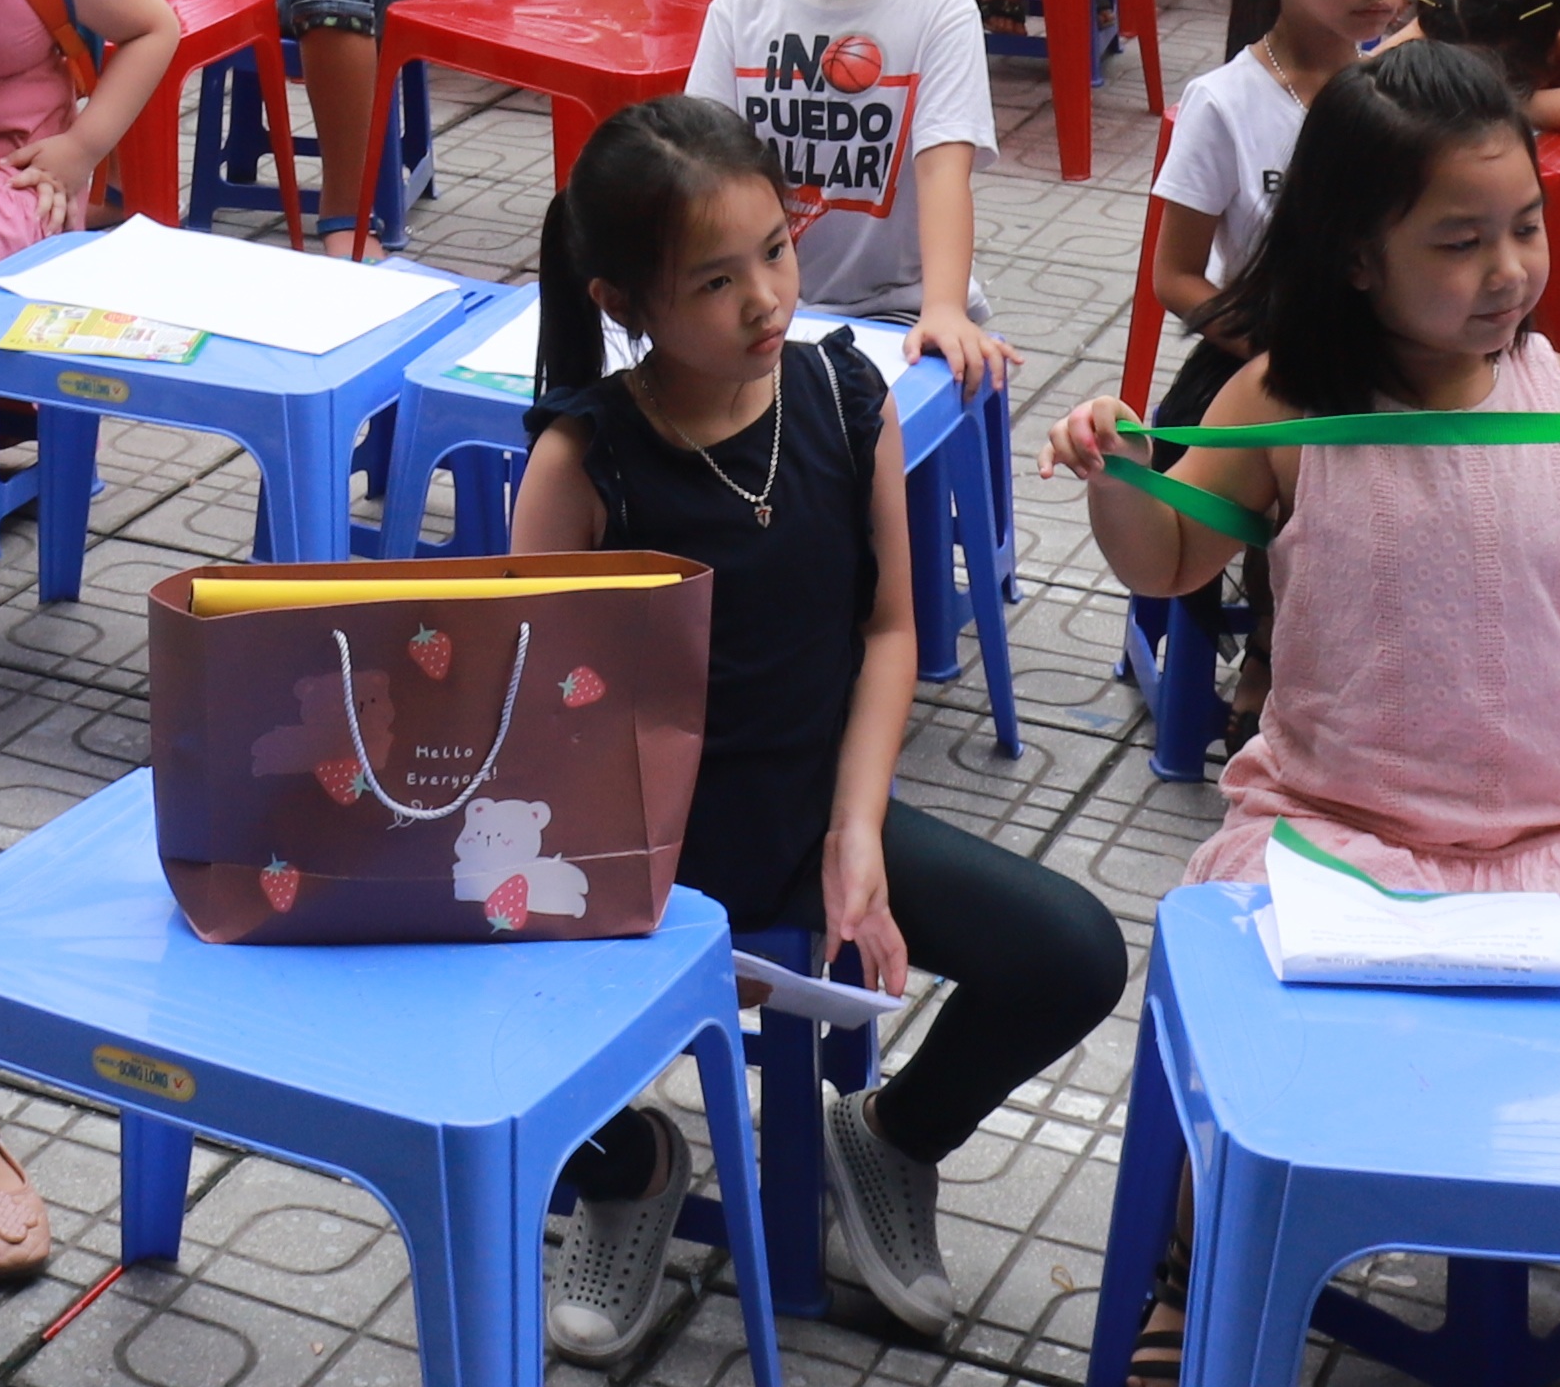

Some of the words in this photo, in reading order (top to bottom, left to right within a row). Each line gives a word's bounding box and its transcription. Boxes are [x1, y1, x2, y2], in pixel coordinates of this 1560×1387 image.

[748, 95, 894, 142] PUEDO
[764, 139, 894, 197] ALLAR!
[415, 745, 474, 760] Hello
[406, 766, 497, 790] Everyoe!
